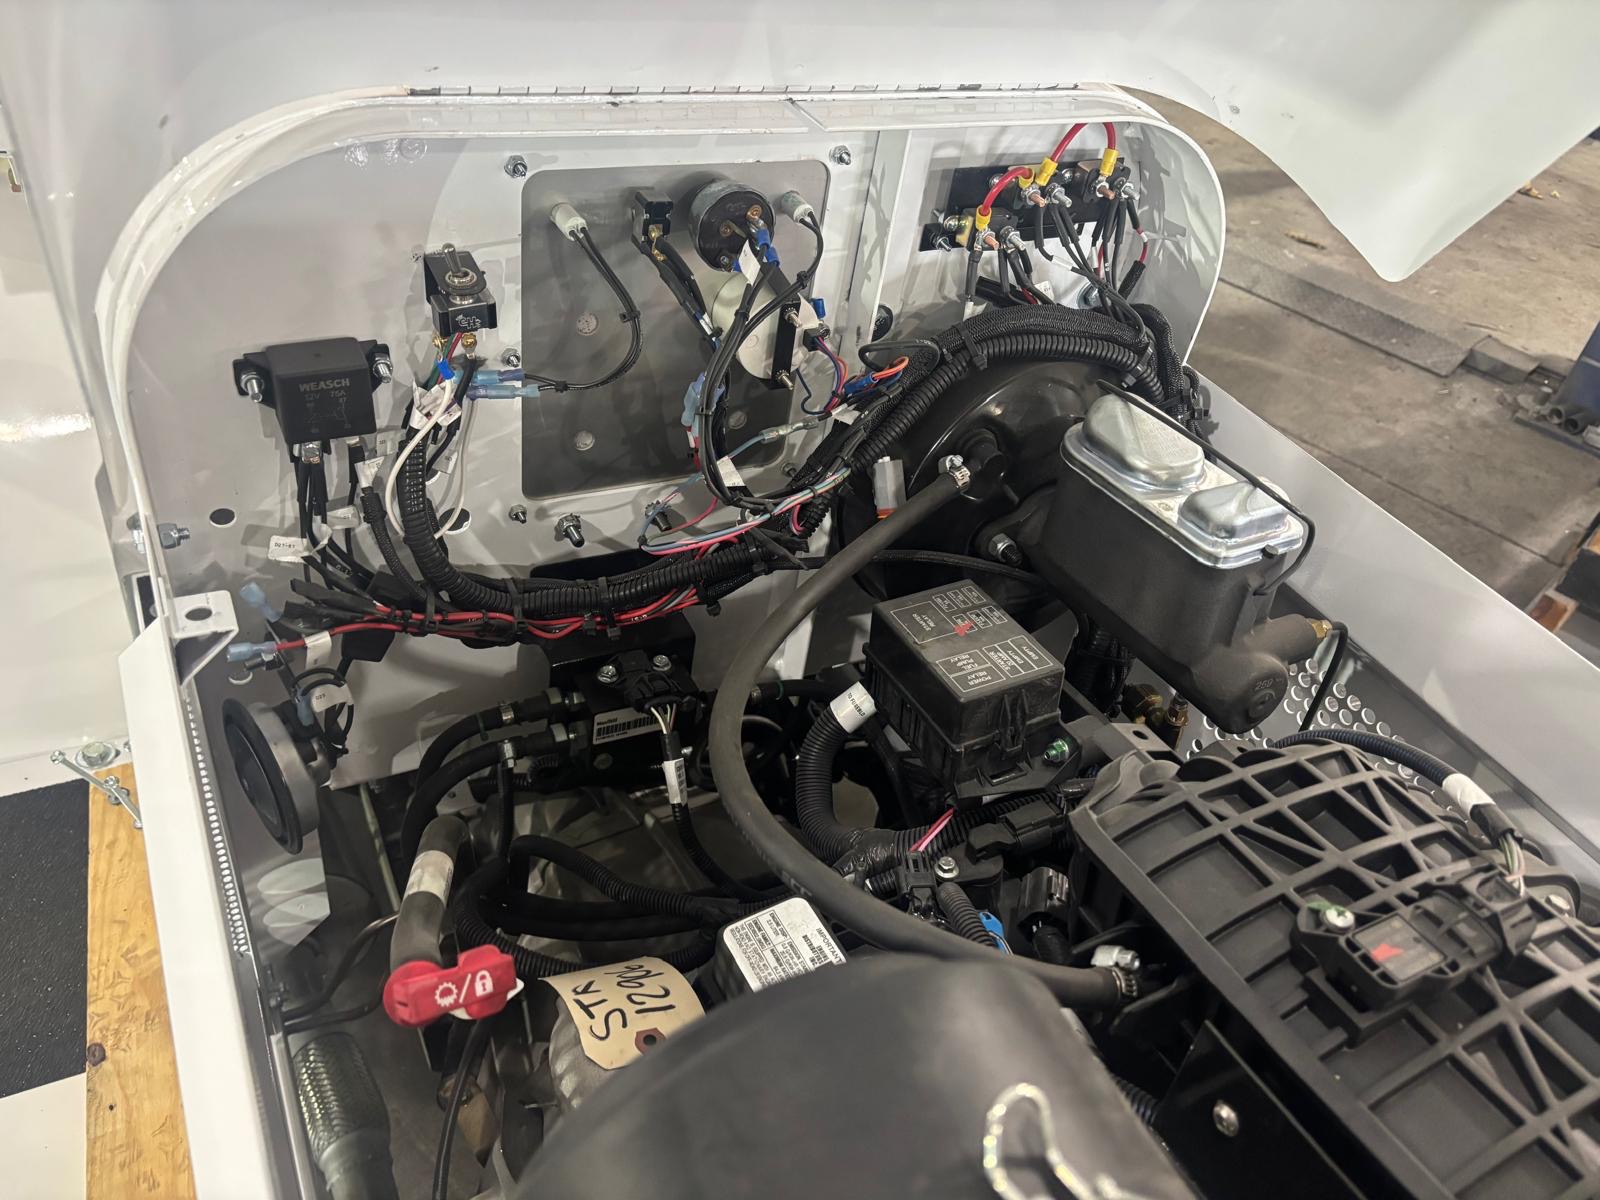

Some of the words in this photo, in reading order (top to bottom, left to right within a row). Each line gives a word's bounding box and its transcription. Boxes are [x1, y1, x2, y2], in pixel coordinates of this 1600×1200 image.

[299, 378, 350, 392] WEASCH
[949, 654, 970, 663] RELAY
[1008, 650, 1024, 664] EMPTY
[1021, 647, 1039, 660] EMPTY
[956, 658, 975, 666] PUMP
[966, 671, 988, 680] RELAY
[968, 675, 992, 686] POWER
[816, 927, 843, 964] IMPORTANT
